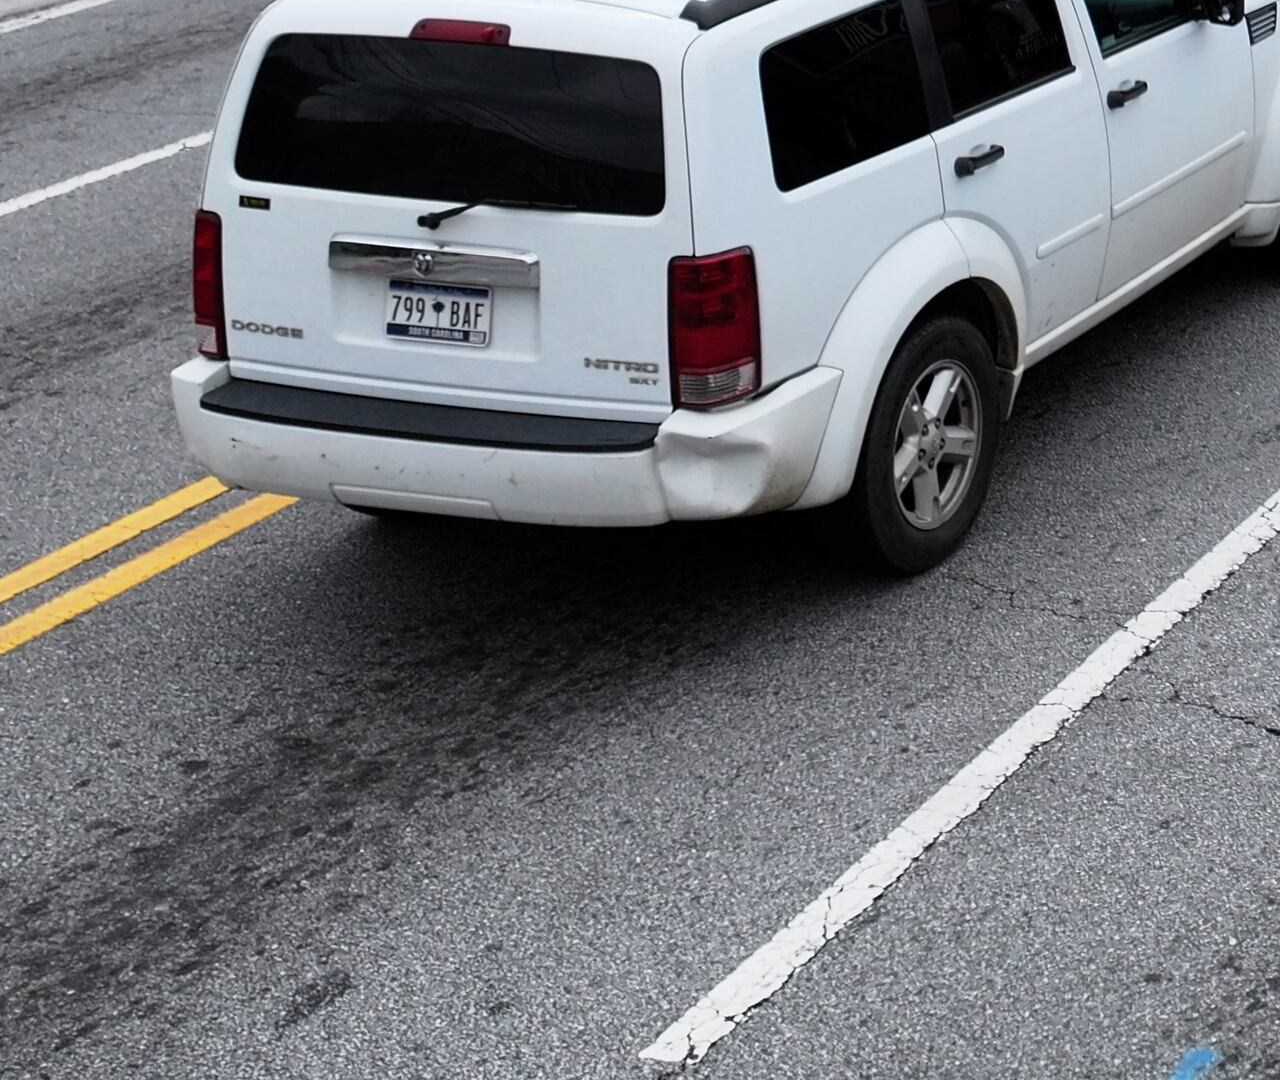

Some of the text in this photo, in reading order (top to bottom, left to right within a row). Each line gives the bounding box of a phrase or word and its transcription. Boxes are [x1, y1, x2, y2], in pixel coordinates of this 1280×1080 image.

[392, 295, 485, 329] 799 BAF
[231, 319, 304, 339] DODGE
[408, 327, 464, 340] SOUTH CAROLINA
[584, 357, 659, 374] NITRO
[629, 377, 660, 386] SXT
